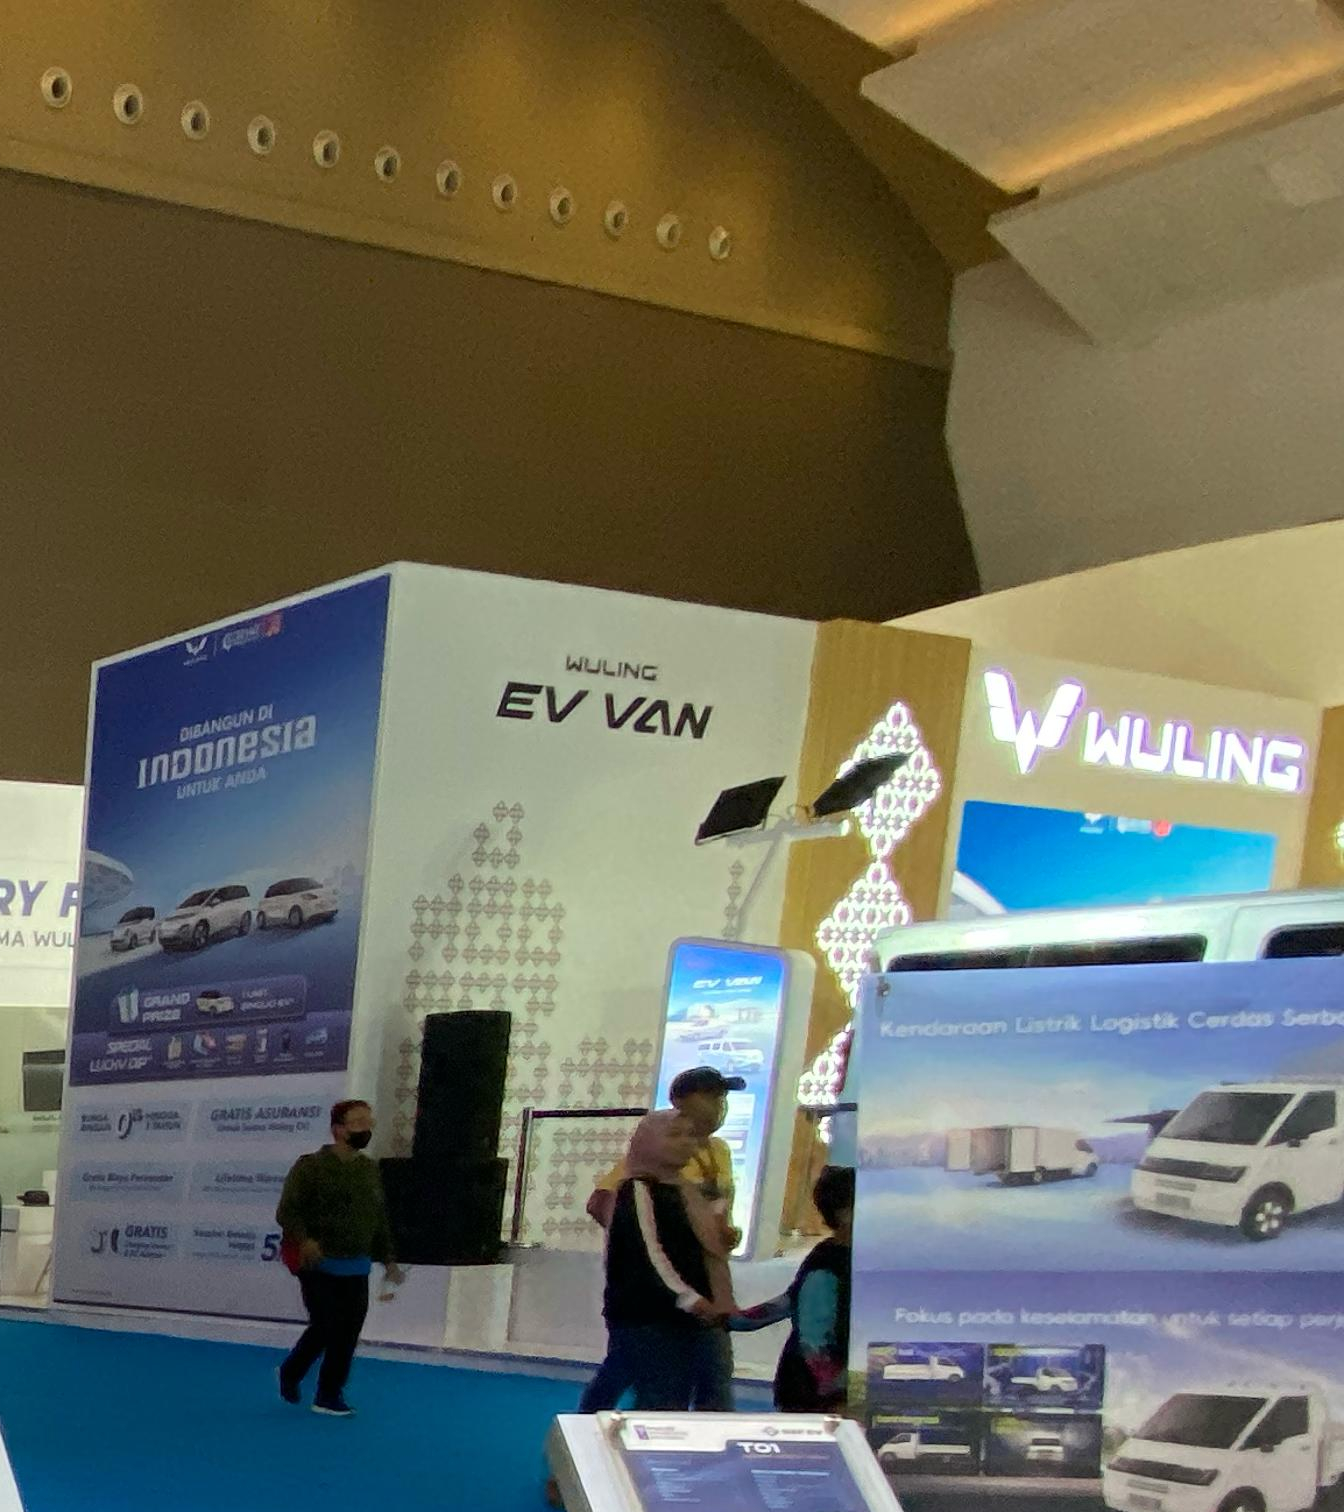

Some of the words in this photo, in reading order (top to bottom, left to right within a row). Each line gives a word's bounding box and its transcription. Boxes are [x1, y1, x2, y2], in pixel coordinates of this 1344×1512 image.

[565, 655, 659, 681] WULING
[497, 682, 590, 723] EV
[605, 693, 713, 739] VAN
[179, 709, 255, 743] DIBANGUN
[1083, 711, 1304, 792] WULING
[880, 1019, 1007, 1038] Kendaraan
[1015, 1013, 1081, 1034] Listrik
[1090, 1011, 1179, 1036] Logistik
[211, 1108, 253, 1120] GRATIS
[125, 1225, 167, 1239] GRATIS
[895, 1307, 953, 1325] Fokus
